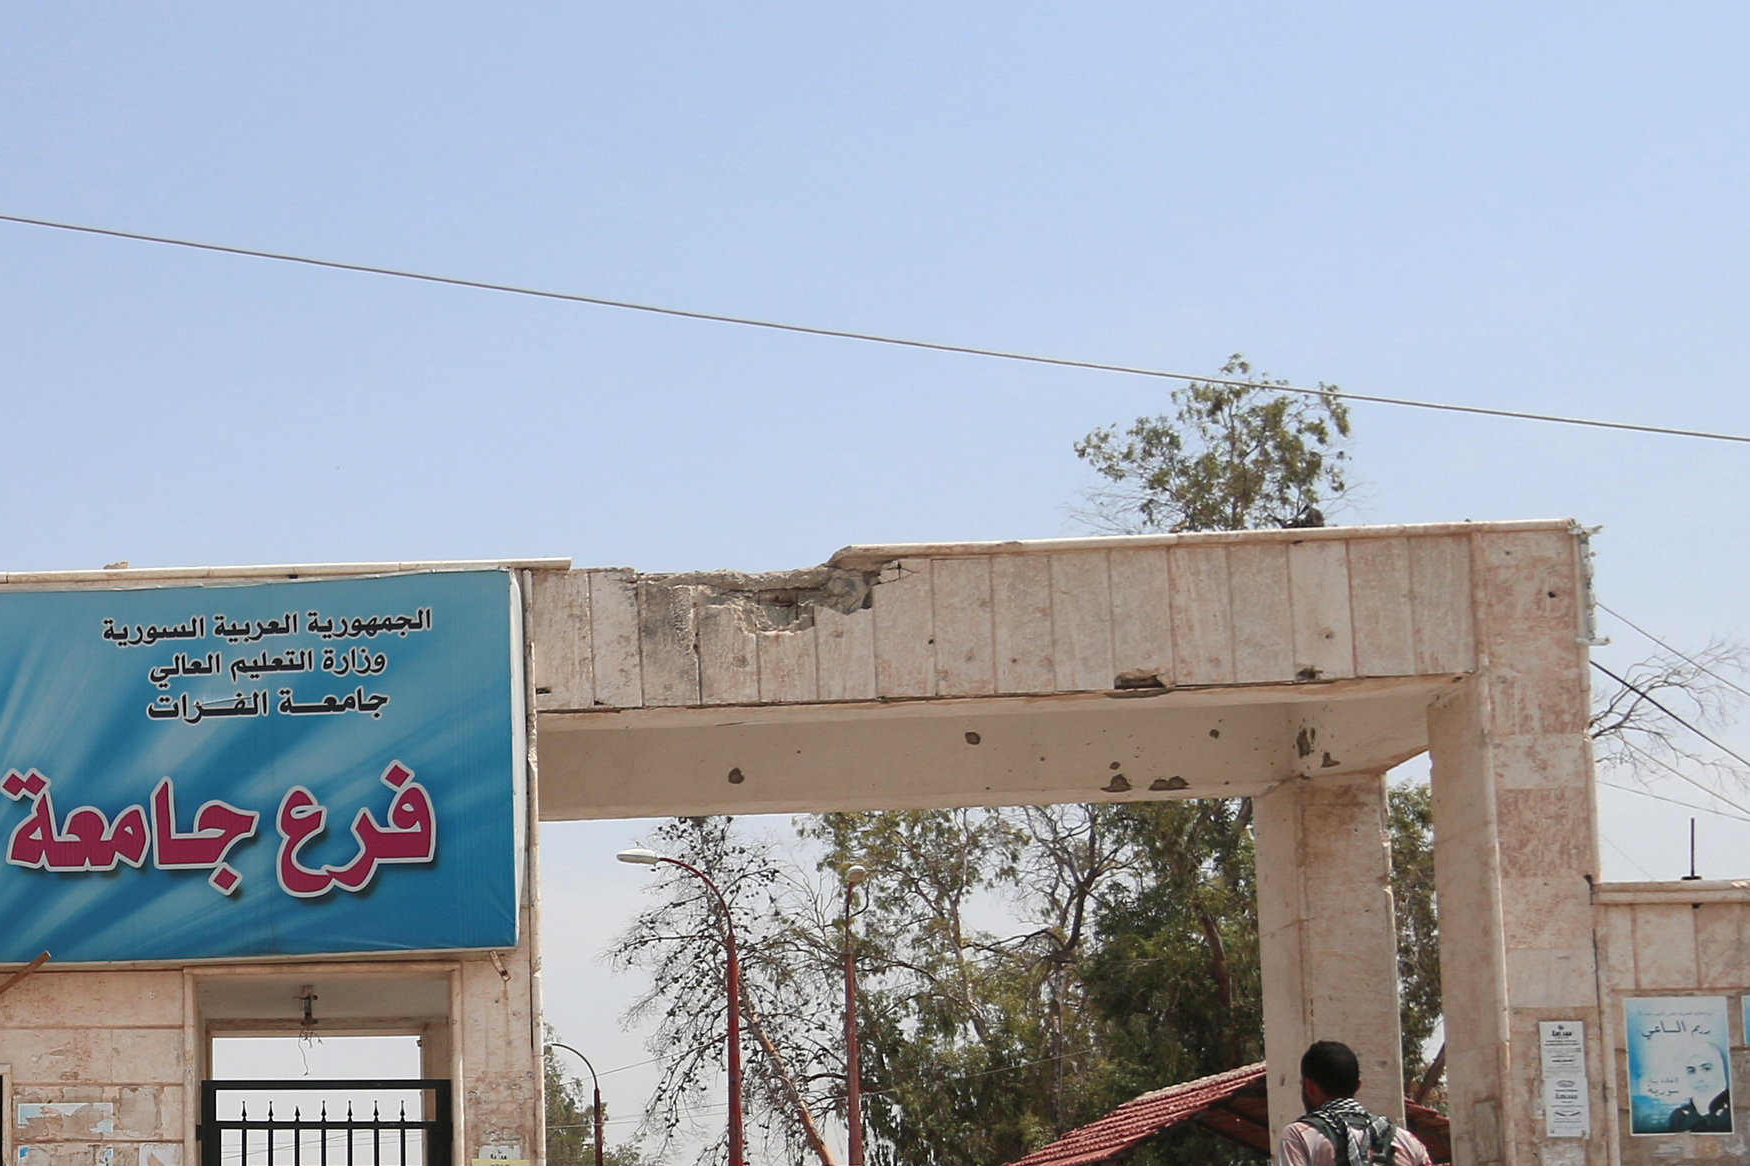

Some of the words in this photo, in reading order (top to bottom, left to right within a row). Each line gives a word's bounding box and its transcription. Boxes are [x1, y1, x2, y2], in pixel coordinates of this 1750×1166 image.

[102, 615, 205, 646] السورية
[213, 611, 298, 643] العربية
[307, 608, 432, 638] الجمهورية
[149, 652, 221, 689] العالي
[229, 648, 314, 683] التعليم
[321, 647, 387, 674] وزارة
[146, 690, 269, 724] الفرات
[278, 685, 389, 719] جامعة
[276, 759, 437, 897] فرع
